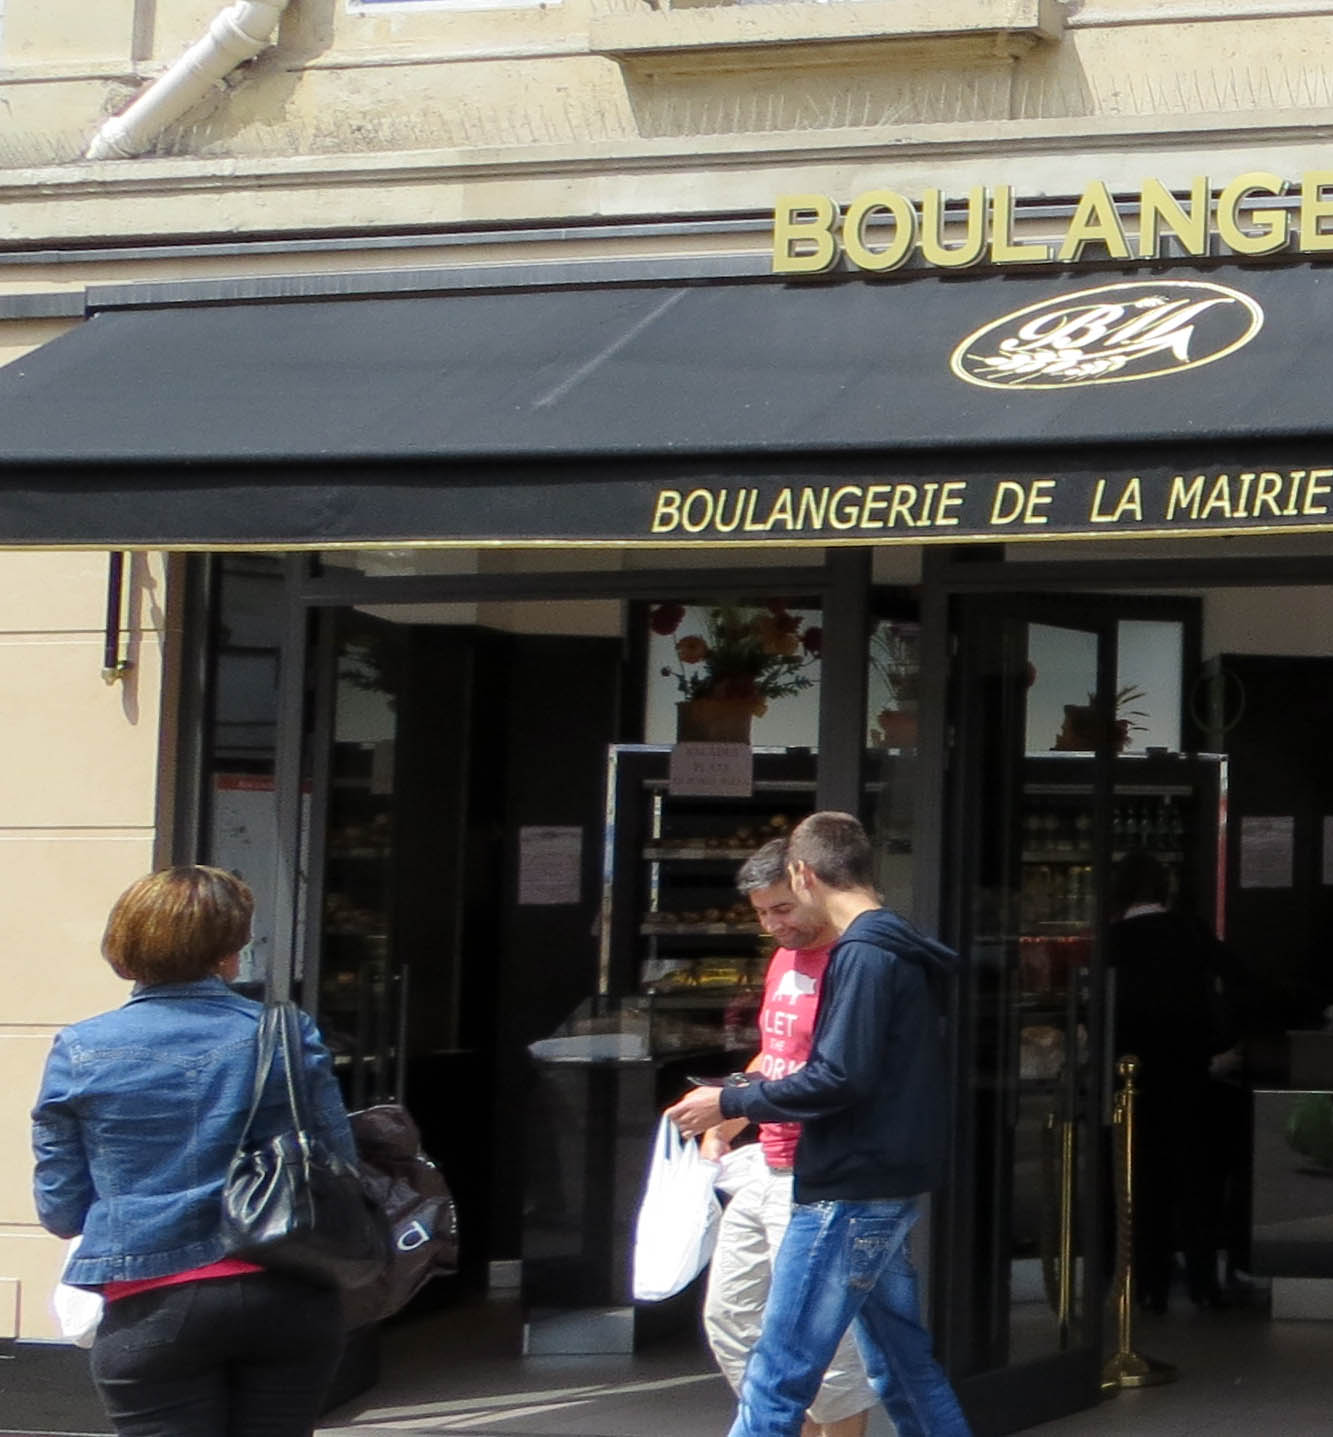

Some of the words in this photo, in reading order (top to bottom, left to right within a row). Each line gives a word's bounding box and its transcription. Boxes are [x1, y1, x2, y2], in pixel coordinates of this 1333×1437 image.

[651, 481, 966, 533] BOULANGERIE
[990, 480, 1056, 524] DE
[1089, 477, 1144, 523] LA
[764, 1009, 798, 1037] LET
[763, 1053, 808, 1081] ORK
